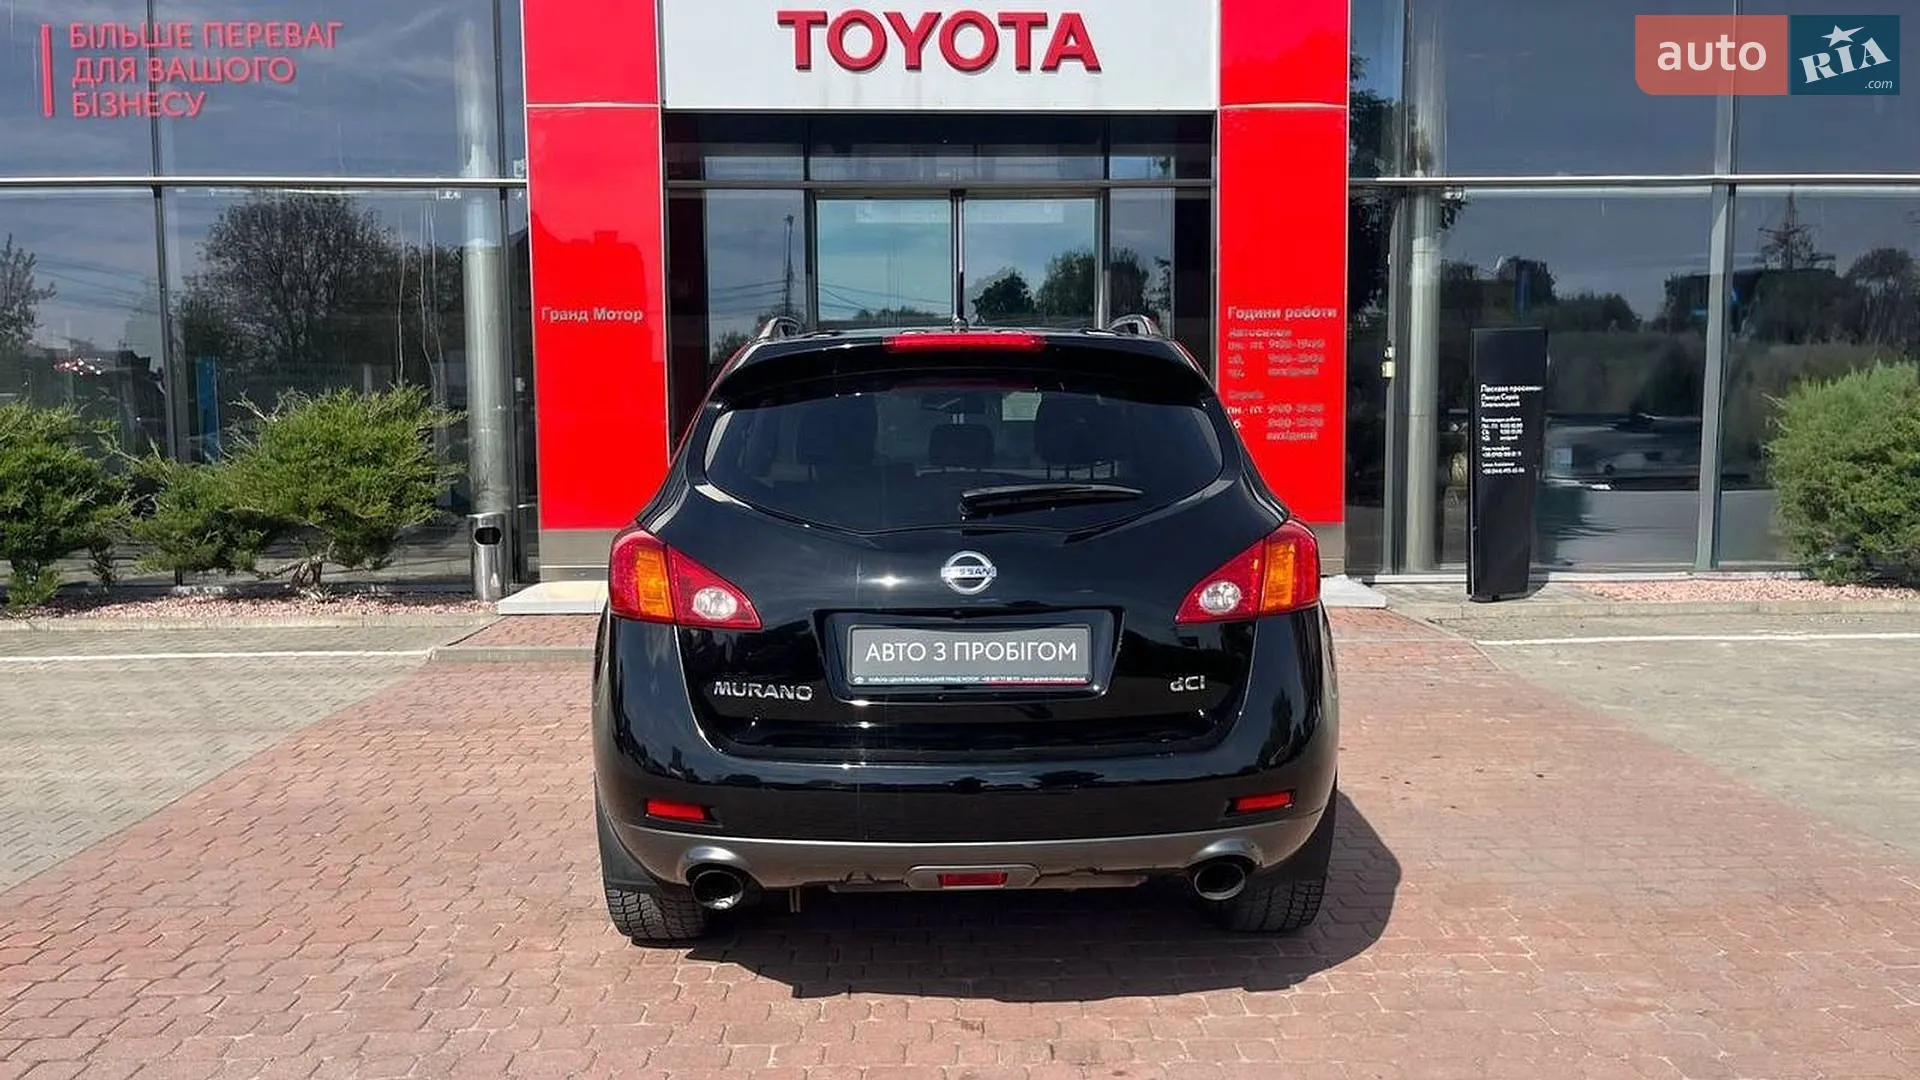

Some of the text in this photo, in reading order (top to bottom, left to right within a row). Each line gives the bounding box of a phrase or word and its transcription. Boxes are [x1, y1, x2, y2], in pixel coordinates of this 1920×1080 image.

[69, 22, 344, 49] БІЛЬШЕ ПЕРЕВАГ
[777, 9, 1102, 72] TOYOTA
[72, 56, 296, 88] ДЛЯ ВАШОГО
[71, 91, 206, 118] БІЗНЕСУ
[541, 307, 644, 323] Гранд Мотор
[1227, 306, 1338, 321] Години роботи
[865, 641, 1078, 662] АВТО З ПРОБІГОМ
[713, 681, 813, 701] MURANO
